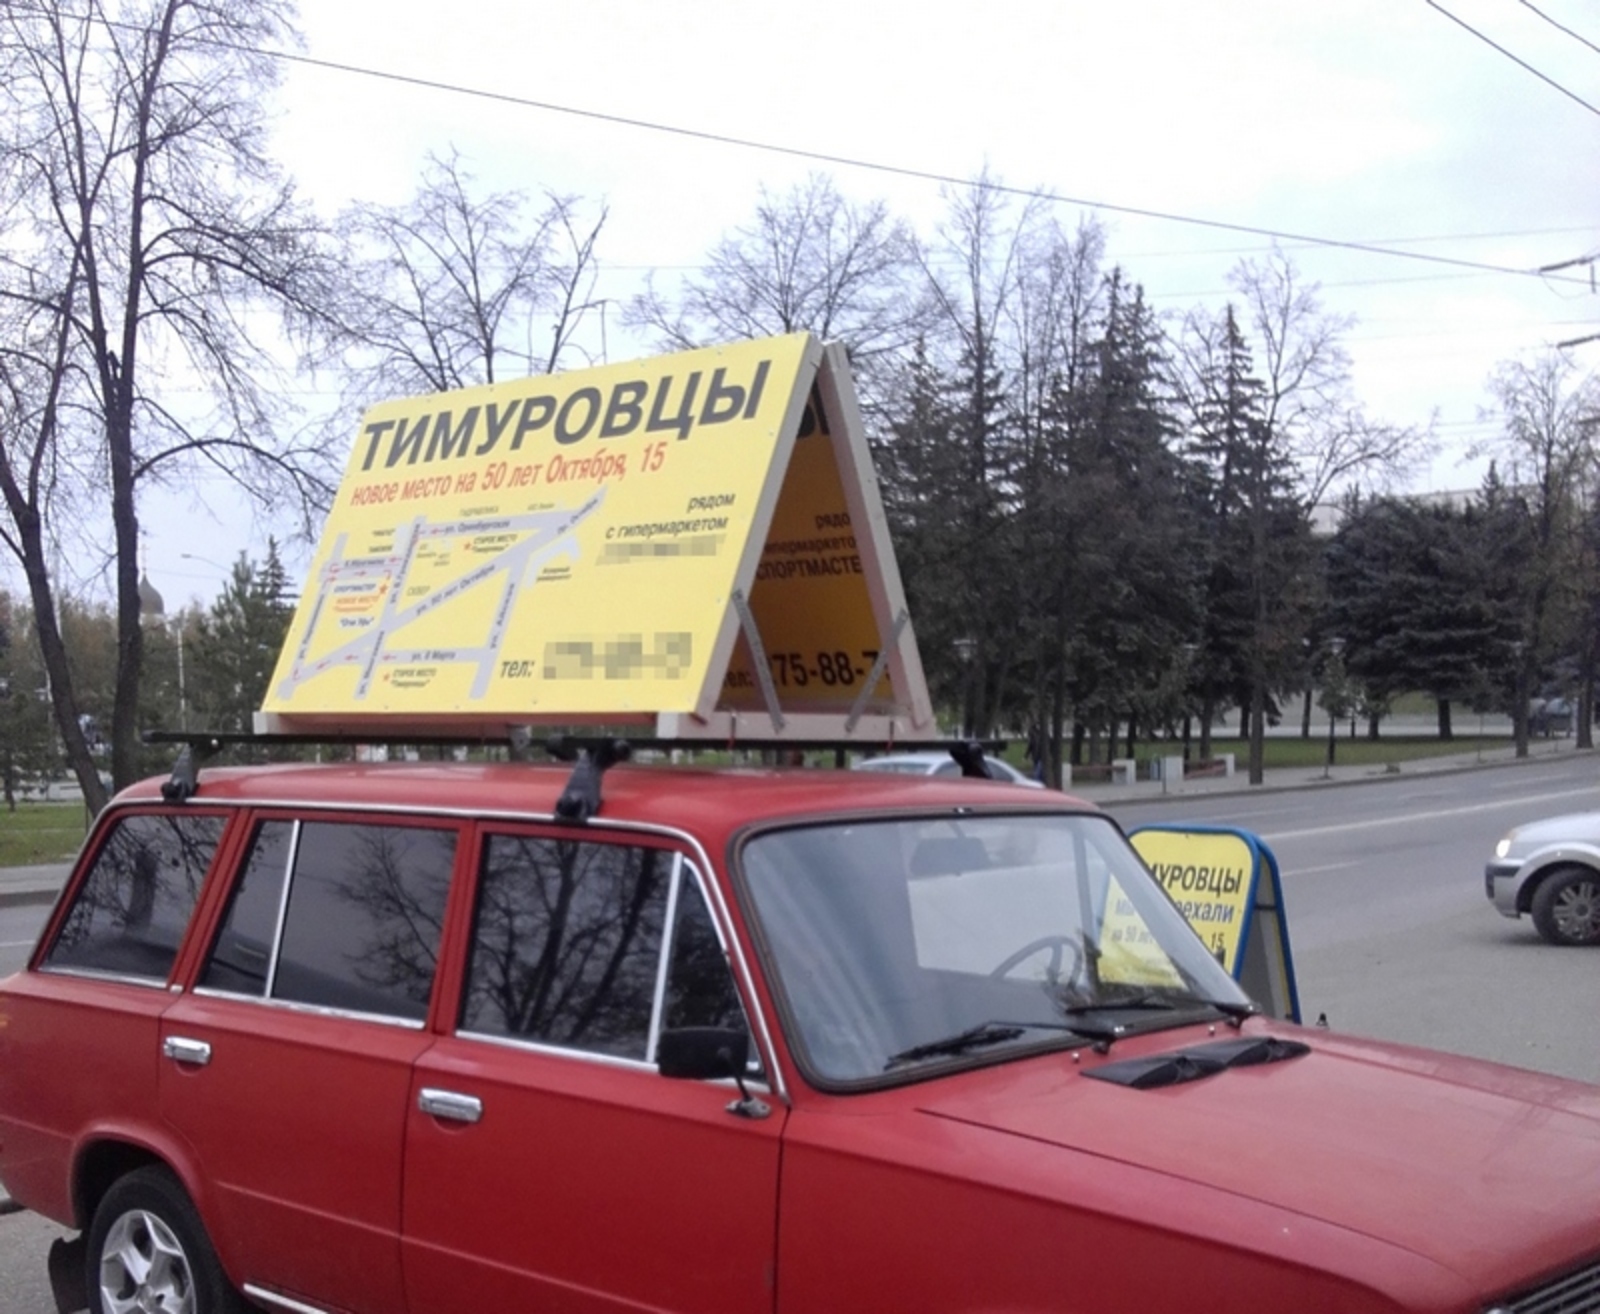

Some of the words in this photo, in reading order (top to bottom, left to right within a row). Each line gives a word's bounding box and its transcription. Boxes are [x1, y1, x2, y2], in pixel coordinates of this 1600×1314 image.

[361, 360, 771, 471] ТИМУРОВЦЫ
[350, 481, 399, 507] новое
[400, 473, 450, 500] место
[457, 471, 475, 494] на
[481, 461, 507, 491] 50
[507, 464, 540, 489] лет
[545, 442, 627, 484] Октября,
[640, 442, 668, 473] 15
[686, 493, 736, 514] рядом
[605, 525, 615, 539] с
[617, 516, 729, 540] гипермаркетом
[500, 659, 535, 678] тел:
